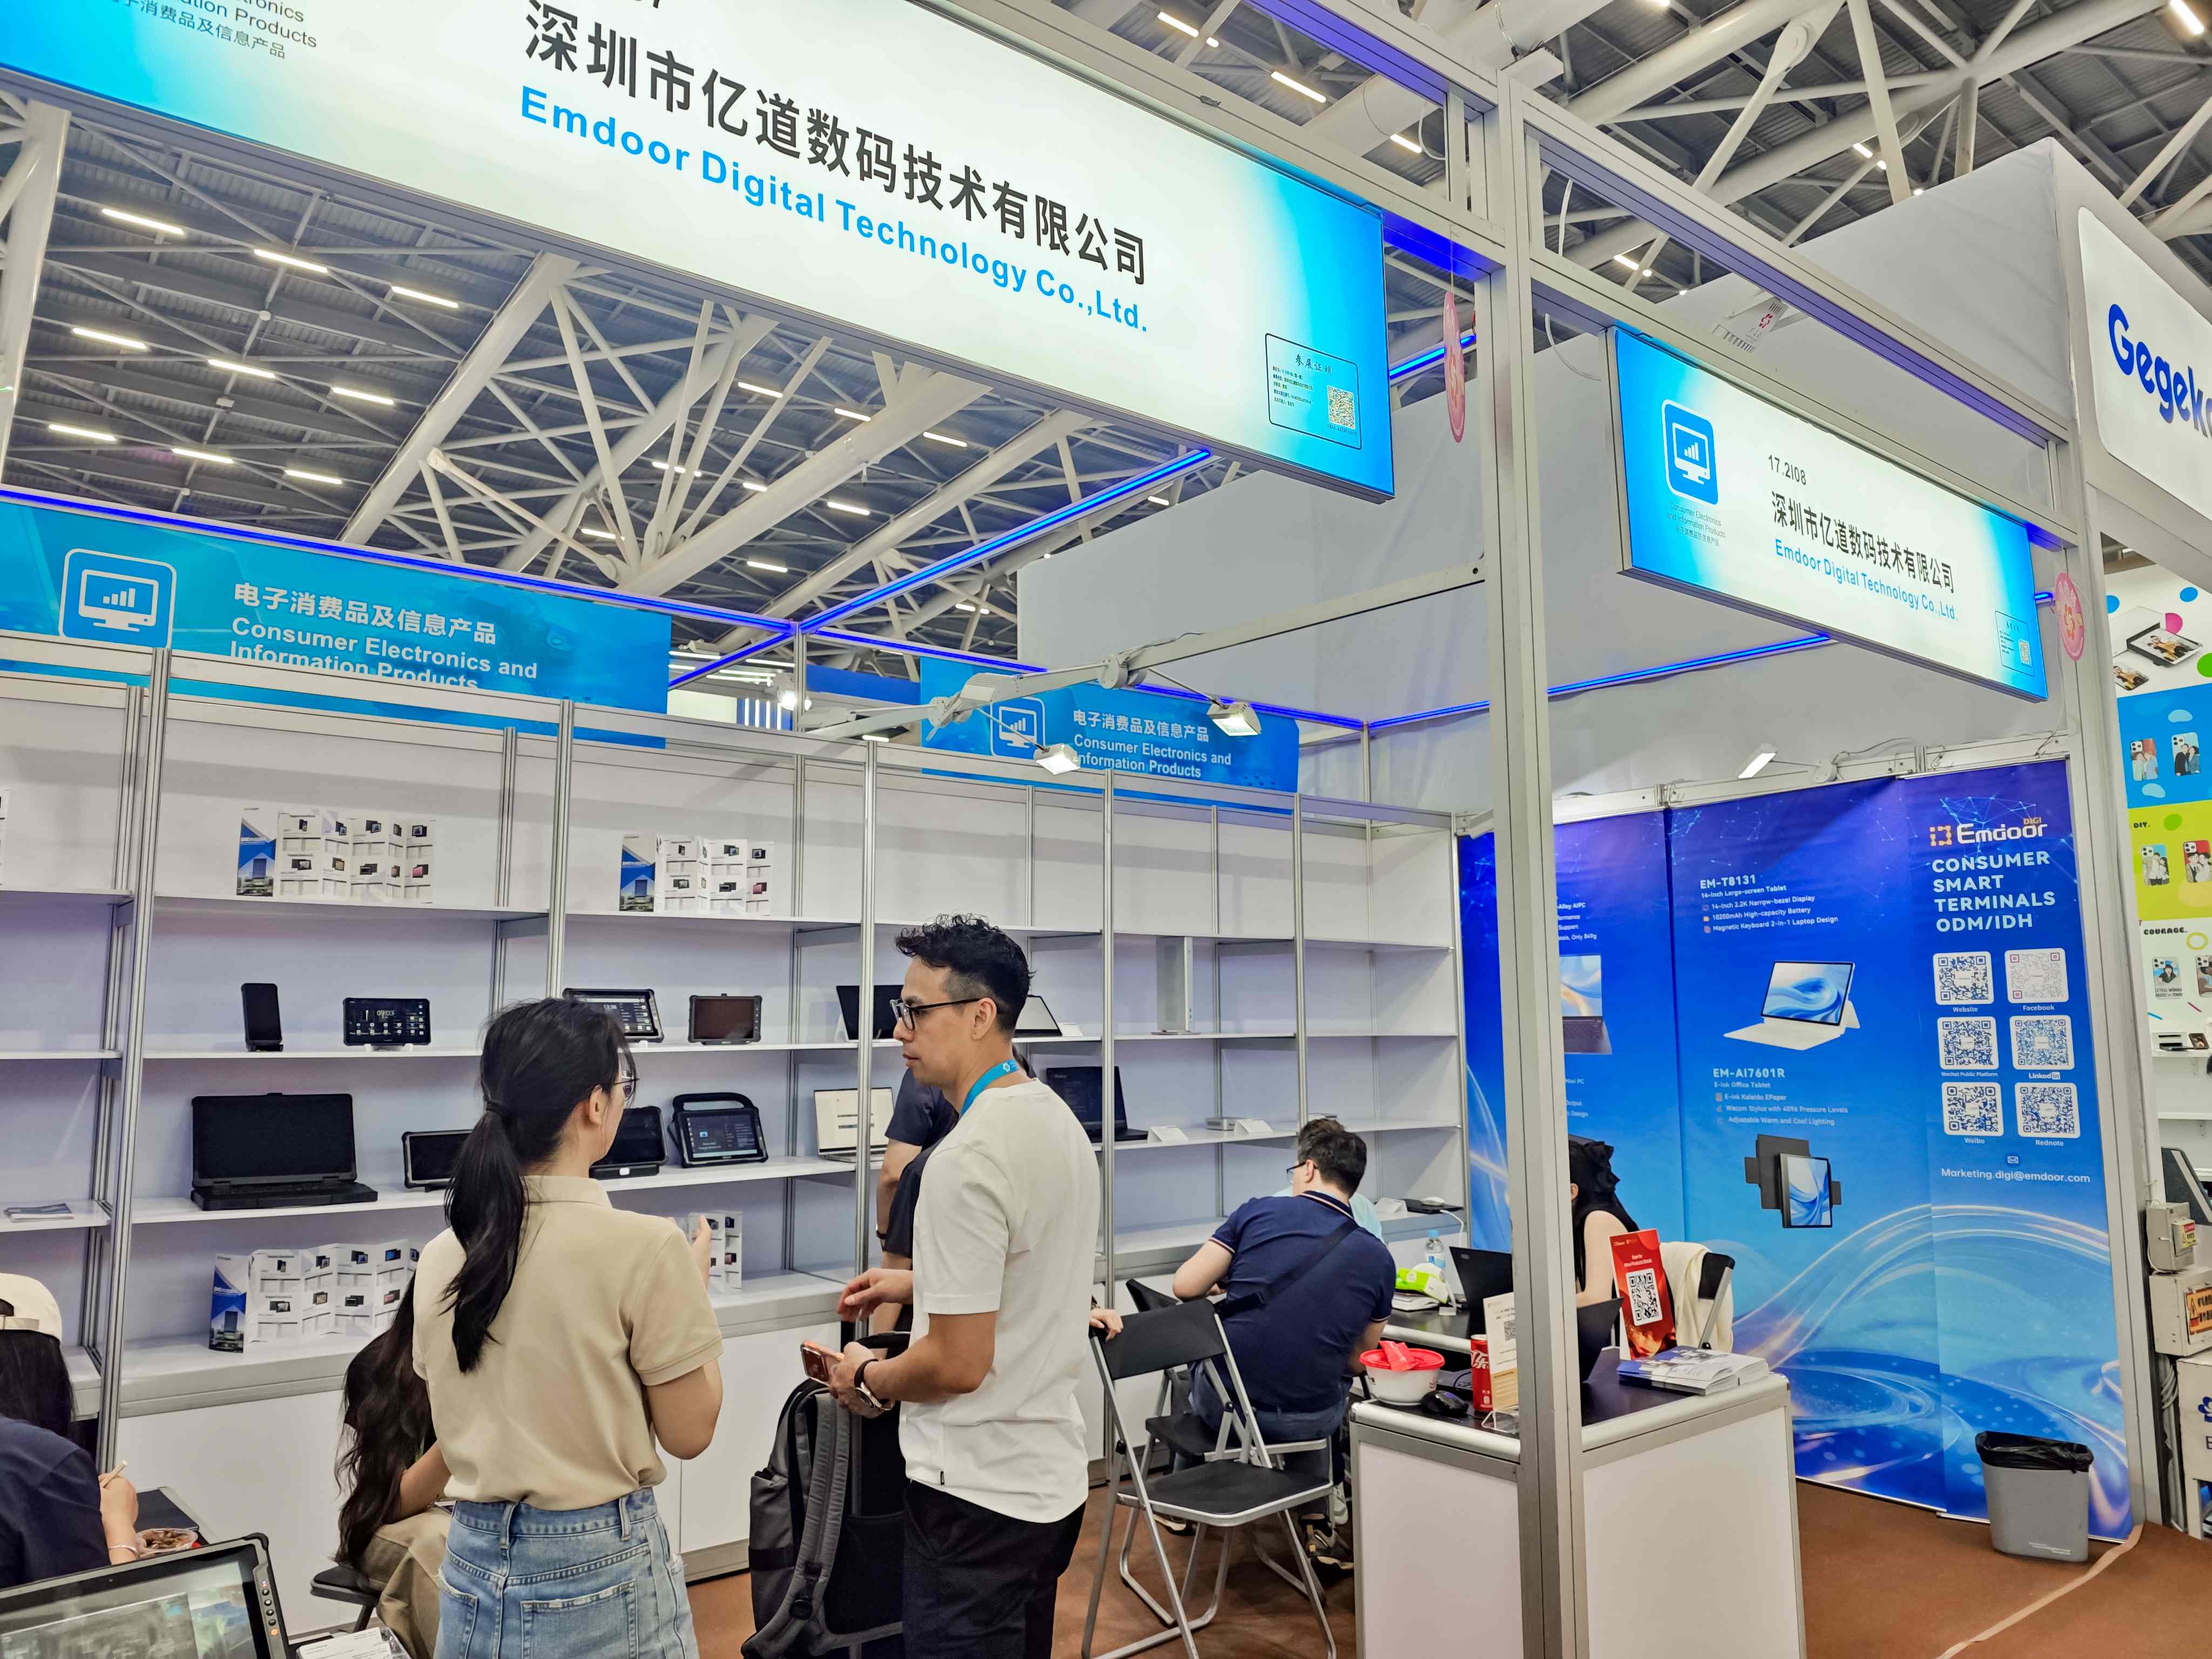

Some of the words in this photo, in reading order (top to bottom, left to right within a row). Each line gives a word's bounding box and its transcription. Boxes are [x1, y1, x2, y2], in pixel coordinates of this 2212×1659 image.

[235, 7, 317, 48] Products
[525, 0, 1145, 285] 深圳市亿道数码技术有限公司
[522, 85, 690, 171] Emdoor
[703, 151, 825, 221] Digital
[835, 200, 1027, 292] Technology
[1037, 269, 1148, 332] Co.,Ltd.
[1669, 502, 1694, 516] Consumer
[1696, 510, 1722, 526] Electronics
[1677, 514, 1704, 530] Information
[1705, 524, 1726, 538] Products
[1771, 491, 1955, 594] 深圳市亿道数码技术有限公司
[1775, 538, 1822, 574] Emdoor
[1824, 558, 1859, 587] Digital
[1861, 572, 1919, 611] Technology
[1922, 594, 1958, 621] Co.,Ltd.
[234, 582, 496, 645] 电子消费品及信息产品
[232, 617, 358, 652] Consumer
[366, 636, 491, 672] Electronics
[498, 662, 537, 679] and
[230, 641, 369, 675] Information
[377, 663, 478, 689] Products
[1073, 709, 1210, 743] 电子消费品及信息产品
[1074, 733, 1139, 754] Consumer
[1142, 743, 1208, 763] Electronics
[1211, 753, 1231, 765] and
[1078, 752, 1145, 771] nformation
[1149, 760, 1202, 778] Products
[1957, 824, 2047, 844] Emdoor
[1932, 851, 2050, 873] CONSUMER
[1700, 874, 1756, 889] EM-T8131
[1724, 886, 1765, 896] Large-screen
[1933, 874, 2004, 893] SMART
[1749, 898, 1790, 907] Narrow-bezel
[1792, 894, 1815, 904] Display
[1934, 891, 2055, 912] TERMINALS
[1712, 923, 1739, 932] Magnetic
[1741, 921, 1769, 929] Keyboard
[1792, 918, 1815, 926] Laptop
[1816, 916, 1838, 924] Design
[1744, 909, 1786, 919] High-capacity
[1788, 907, 1811, 916] Battery
[1936, 914, 2033, 932] ODM/IDH
[1941, 1168, 2090, 1183] Marketing.digi@emdoor.com
